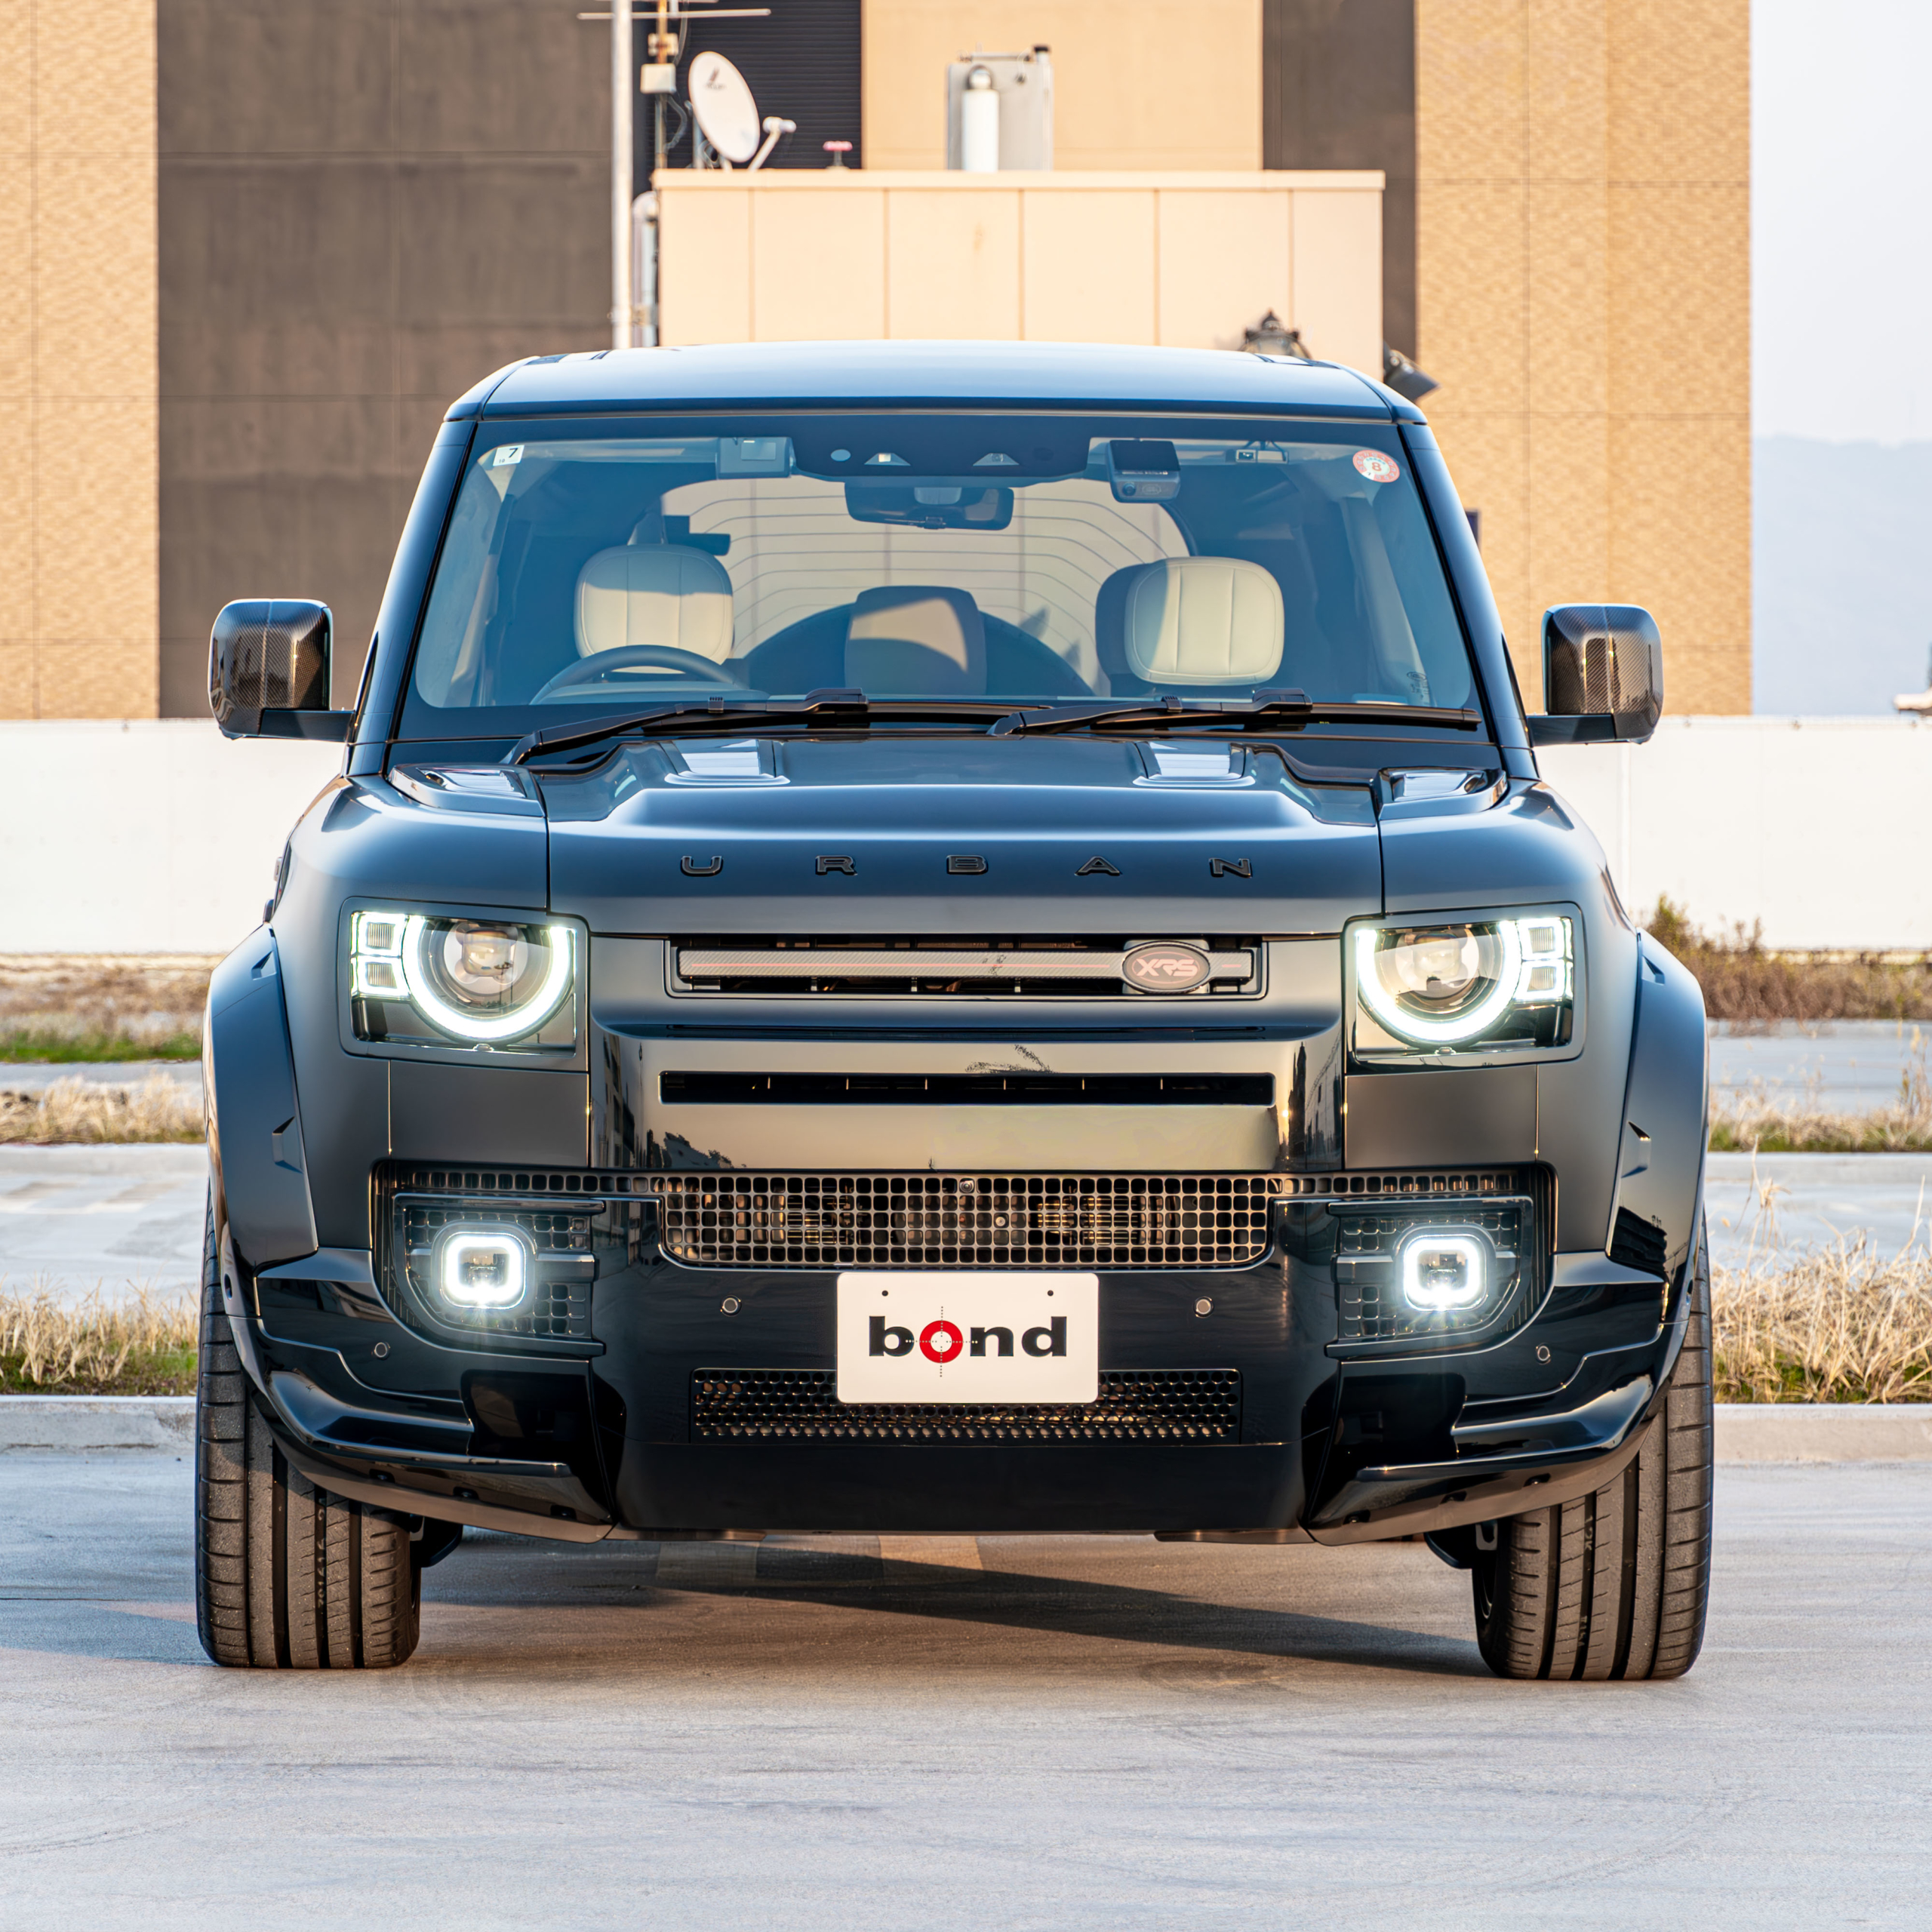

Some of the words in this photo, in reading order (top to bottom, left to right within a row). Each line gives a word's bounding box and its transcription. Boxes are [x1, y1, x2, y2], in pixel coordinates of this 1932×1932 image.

[508, 448, 518, 458] 7
[1372, 462, 1382, 472] 8
[680, 854, 1254, 878] URBAN
[1136, 958, 1198, 977] XRS
[869, 1315, 1067, 1363] bond
